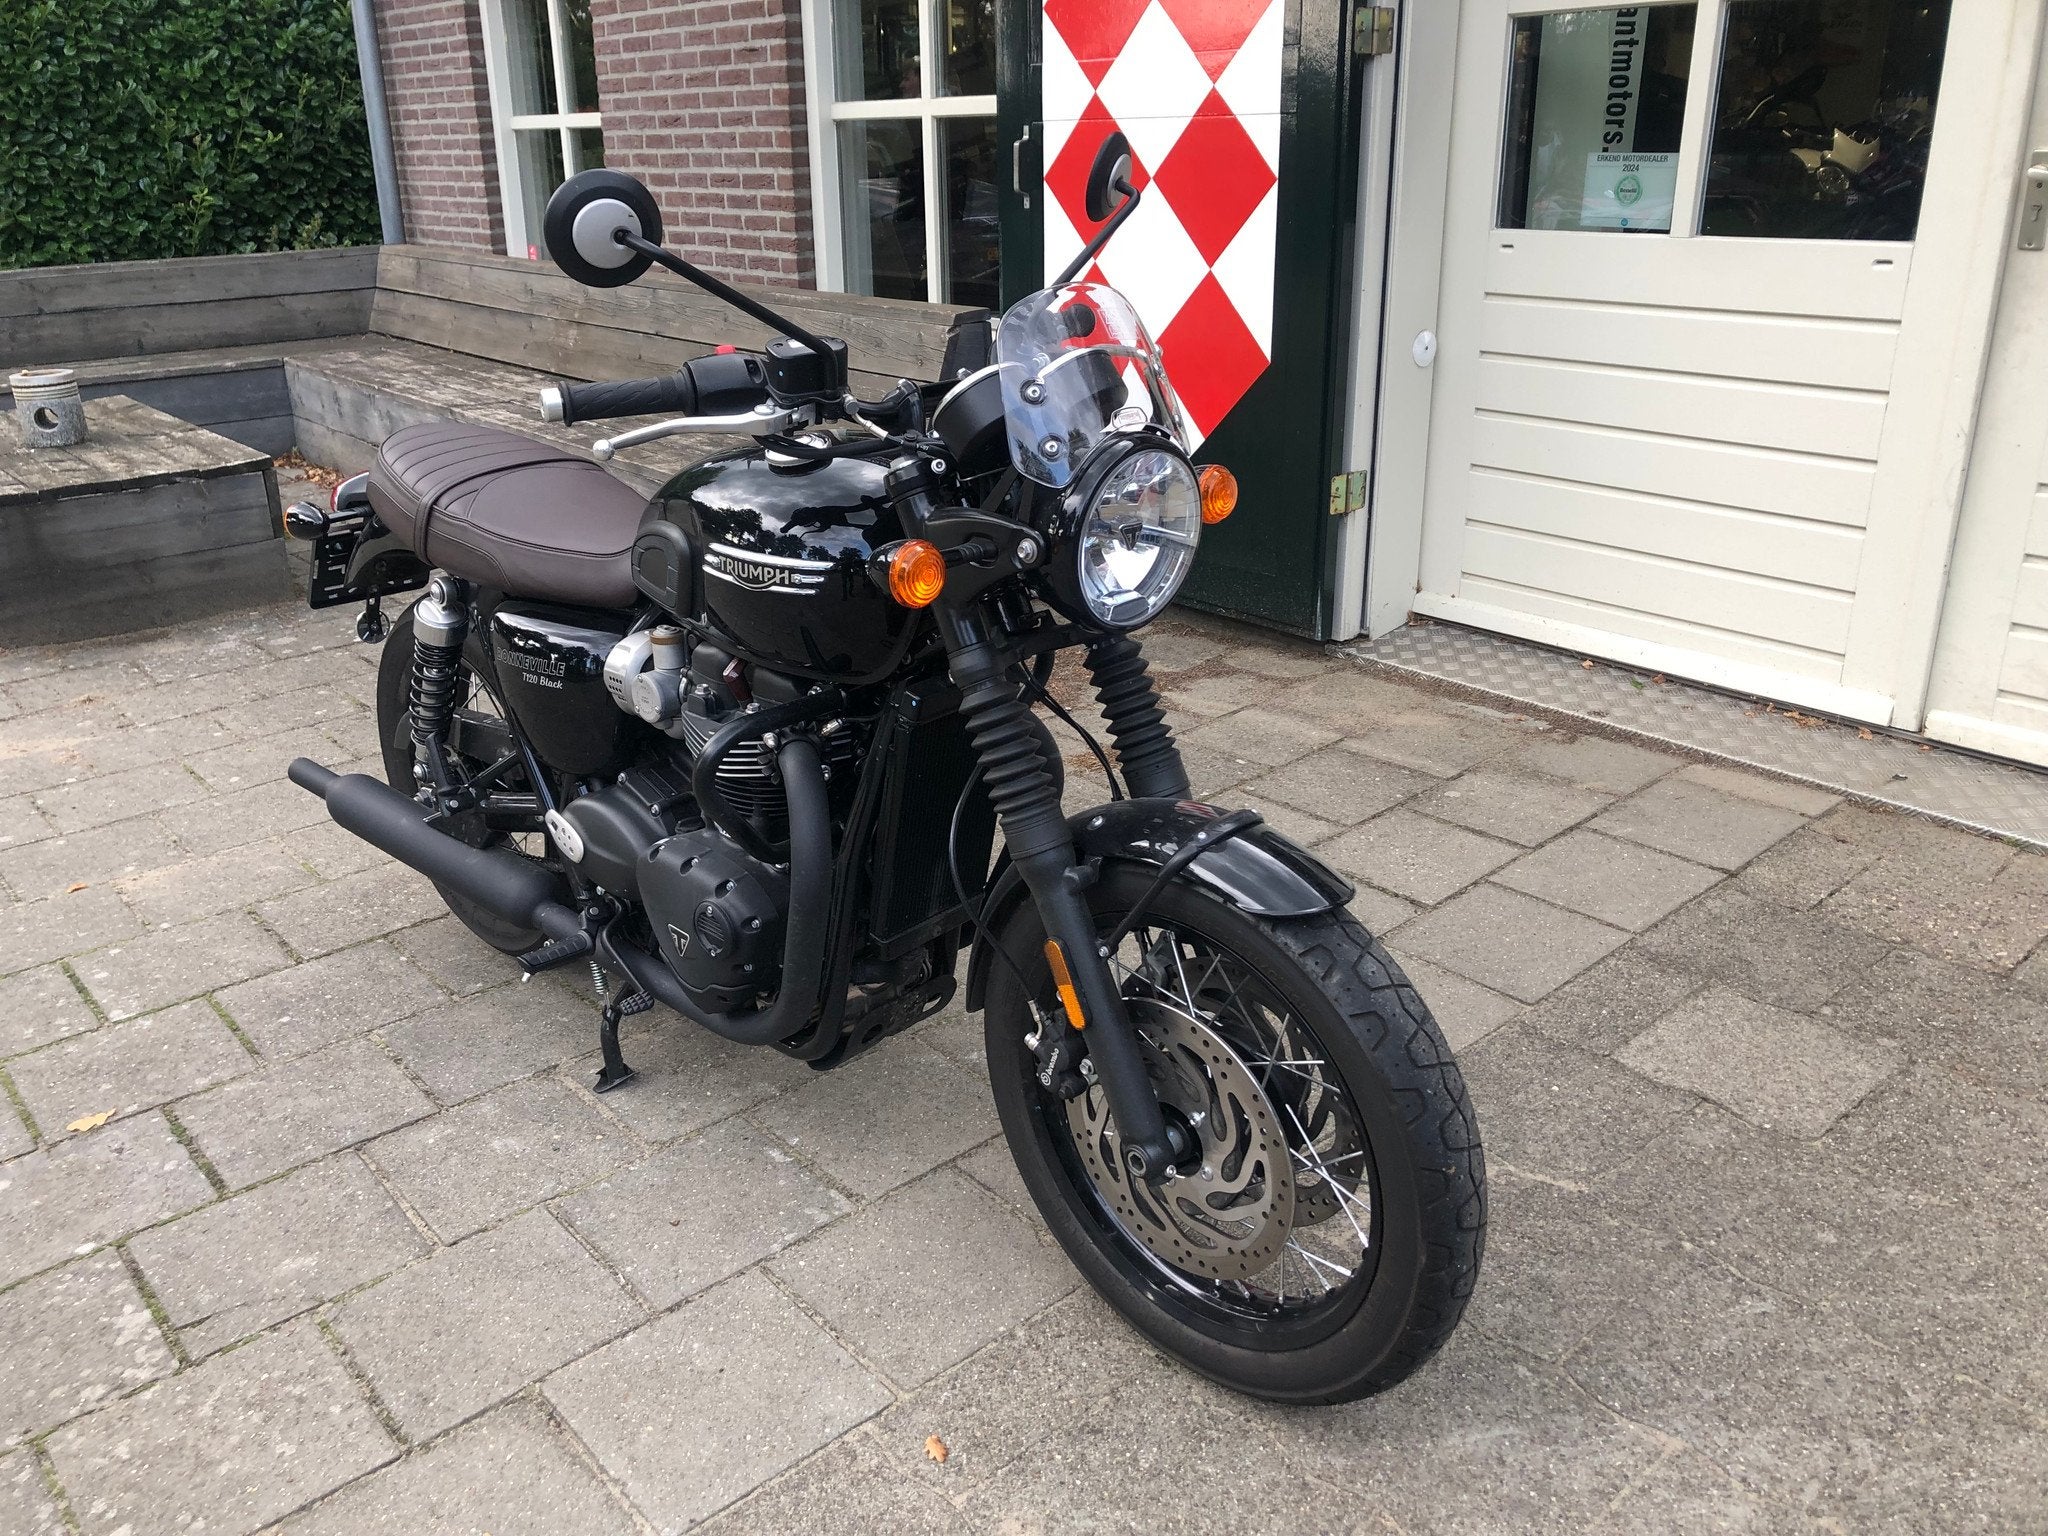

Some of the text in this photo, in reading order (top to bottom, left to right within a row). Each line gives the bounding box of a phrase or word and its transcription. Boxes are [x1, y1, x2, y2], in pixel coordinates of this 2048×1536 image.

[1597, 154, 1669, 163] ERKEND MOTORDEALER
[1622, 163, 1640, 172] 2024
[718, 555, 790, 587] TRIUMPH
[496, 646, 566, 677] BONNEVILLE
[522, 671, 563, 690] T120 Black
